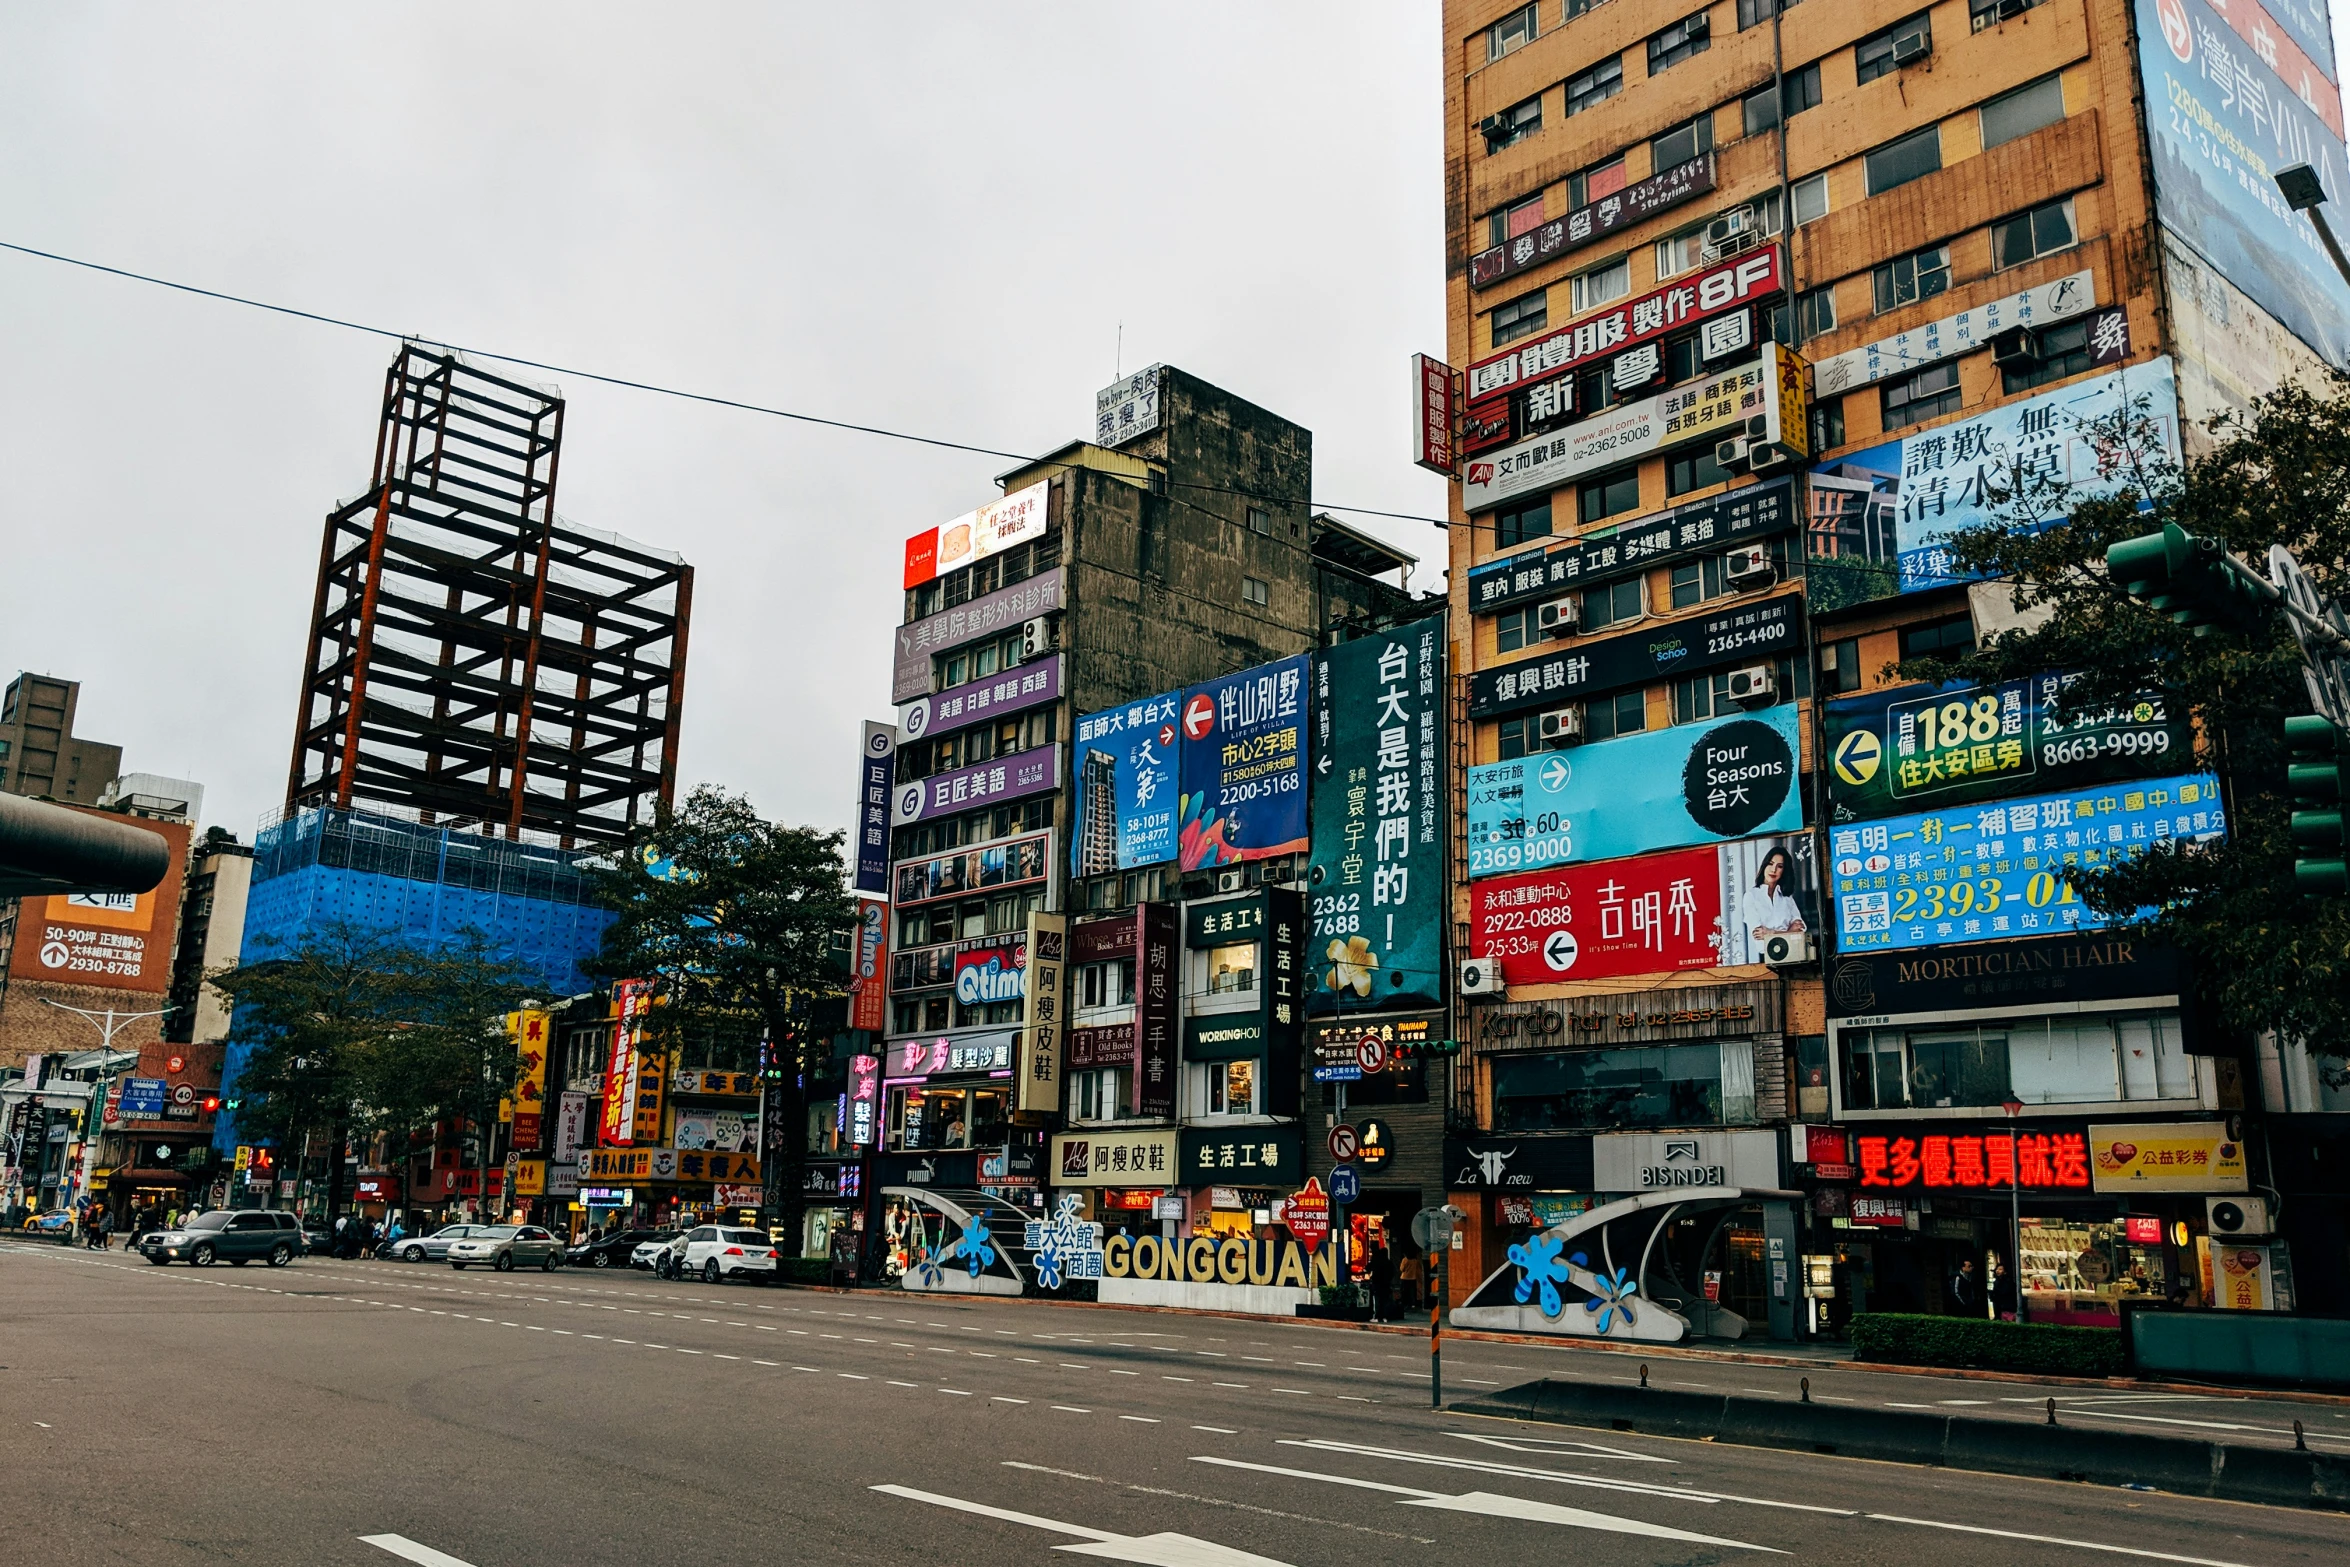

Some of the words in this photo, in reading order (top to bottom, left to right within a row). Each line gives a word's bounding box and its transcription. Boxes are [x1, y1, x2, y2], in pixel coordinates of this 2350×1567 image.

[1470, 253, 1771, 399] 團體服製作8F
[1529, 308, 1753, 424] 新學園
[1665, 391, 1697, 416] 法語
[1666, 399, 1732, 435] 西班牙語
[1428, 371, 1446, 465] 團體服製作
[1573, 412, 1650, 445] www.anl.com.tw
[1573, 432, 1617, 462] 02-2362
[1620, 425, 1650, 446] 5008
[1499, 438, 1566, 478] 艾而歐語
[1479, 562, 1502, 574] Interior
[1517, 549, 1543, 563] Fashion
[1554, 539, 1574, 551] Visual
[1634, 515, 1658, 528] Digital
[1684, 500, 1708, 513] Sketch
[1732, 482, 1765, 499] Creative
[1481, 577, 1508, 602] 室內
[1515, 567, 1544, 592] 服裝
[1550, 557, 1581, 581] 廣告
[1586, 545, 1617, 572] 工設
[1625, 529, 1671, 560] 多媒體
[1680, 517, 1714, 545] 素描
[915, 580, 1056, 652] 美學院整形外科診所
[1761, 606, 1782, 621] 創新
[1649, 637, 1681, 653] Design
[1708, 623, 1786, 655] 2365-4400
[1495, 655, 1590, 702] 復興設計
[939, 697, 963, 721] 美語
[967, 688, 991, 711] 日語
[993, 679, 1019, 704] 韓語
[1021, 669, 1048, 695] 西語
[1219, 667, 1299, 733] 伴山別墅
[1231, 729, 1247, 739] LIFE
[1250, 725, 1259, 733] OF
[1262, 719, 1285, 730] VILLA
[1897, 712, 1915, 757] 自備
[1917, 696, 1999, 753] 188
[2001, 689, 2022, 737] 萬起
[1221, 726, 1298, 767] 市心2字頭
[1706, 744, 1749, 765] Four
[2043, 730, 2170, 767] 8663-9999
[1471, 764, 1524, 786] 大安行旅
[1706, 762, 1786, 786] Seasons.
[1898, 740, 2023, 788] 住大安區旁
[934, 766, 1006, 809] 巨匠美語
[1220, 772, 1300, 806] 2200-5168
[1706, 785, 1750, 811] 台大
[866, 765, 886, 847] 巨匠美語
[1126, 812, 1170, 833] 58-101坪
[1126, 827, 1169, 846] 2368-8777
[1471, 832, 1488, 845] 大學
[1537, 811, 1559, 833] 60
[1834, 799, 2073, 857] 高明一對一補習班
[1471, 846, 1521, 871] 2369
[1524, 836, 1572, 863] 9000
[1313, 893, 1360, 916] 2362
[1484, 881, 1572, 911] 永和運動中心
[1846, 894, 1885, 913] 古亭
[1313, 914, 1360, 937] 7688
[1484, 906, 1572, 934] 2922-0888
[1848, 913, 1885, 931] 分校
[45, 926, 97, 944] 50-90坪
[1076, 933, 1109, 949] Whose
[1097, 941, 1114, 952] Books
[1602, 942, 1620, 952] Show
[1622, 941, 1638, 950] Time
[68, 957, 141, 977] 2930-8788
[1276, 923, 1292, 1025] 生活工場
[1898, 949, 2051, 983] MORTICIAN
[2063, 941, 2137, 969] HAIR
[1034, 966, 1058, 1082] 阿瘦皮鞋
[1148, 942, 1167, 1083] 胡思二手書
[950, 1046, 1009, 1069] 髮型沙龍
[1098, 1041, 1111, 1051] Old
[1112, 1040, 1133, 1050] Books
[1325, 1068, 1332, 1080] P
[177, 1091, 191, 1100] 40
[514, 1126, 538, 1134] CHENG
[853, 1101, 871, 1145] 髮型
[514, 1135, 537, 1143] HIANG
[1011, 1160, 1031, 1170] PUMA
[1094, 1143, 1165, 1173] 阿瘦皮鞋
[1199, 1143, 1279, 1168] 生活工場
[1858, 1132, 2090, 1188] 更多優惠買就送
[2142, 1149, 2208, 1166] 公益彩券
[906, 1170, 930, 1183] PUMA
[1454, 1166, 1477, 1186] La
[1506, 1173, 1534, 1186] new
[1507, 1213, 1530, 1224] 100%
[1853, 1199, 1886, 1218] 復興
[1024, 1222, 1094, 1250] 臺大公館
[1294, 1220, 1311, 1230] 2363
[1312, 1221, 1327, 1230] 1688
[1065, 1251, 1103, 1278] 商圈
[1104, 1234, 1337, 1289] GONGGUAN
